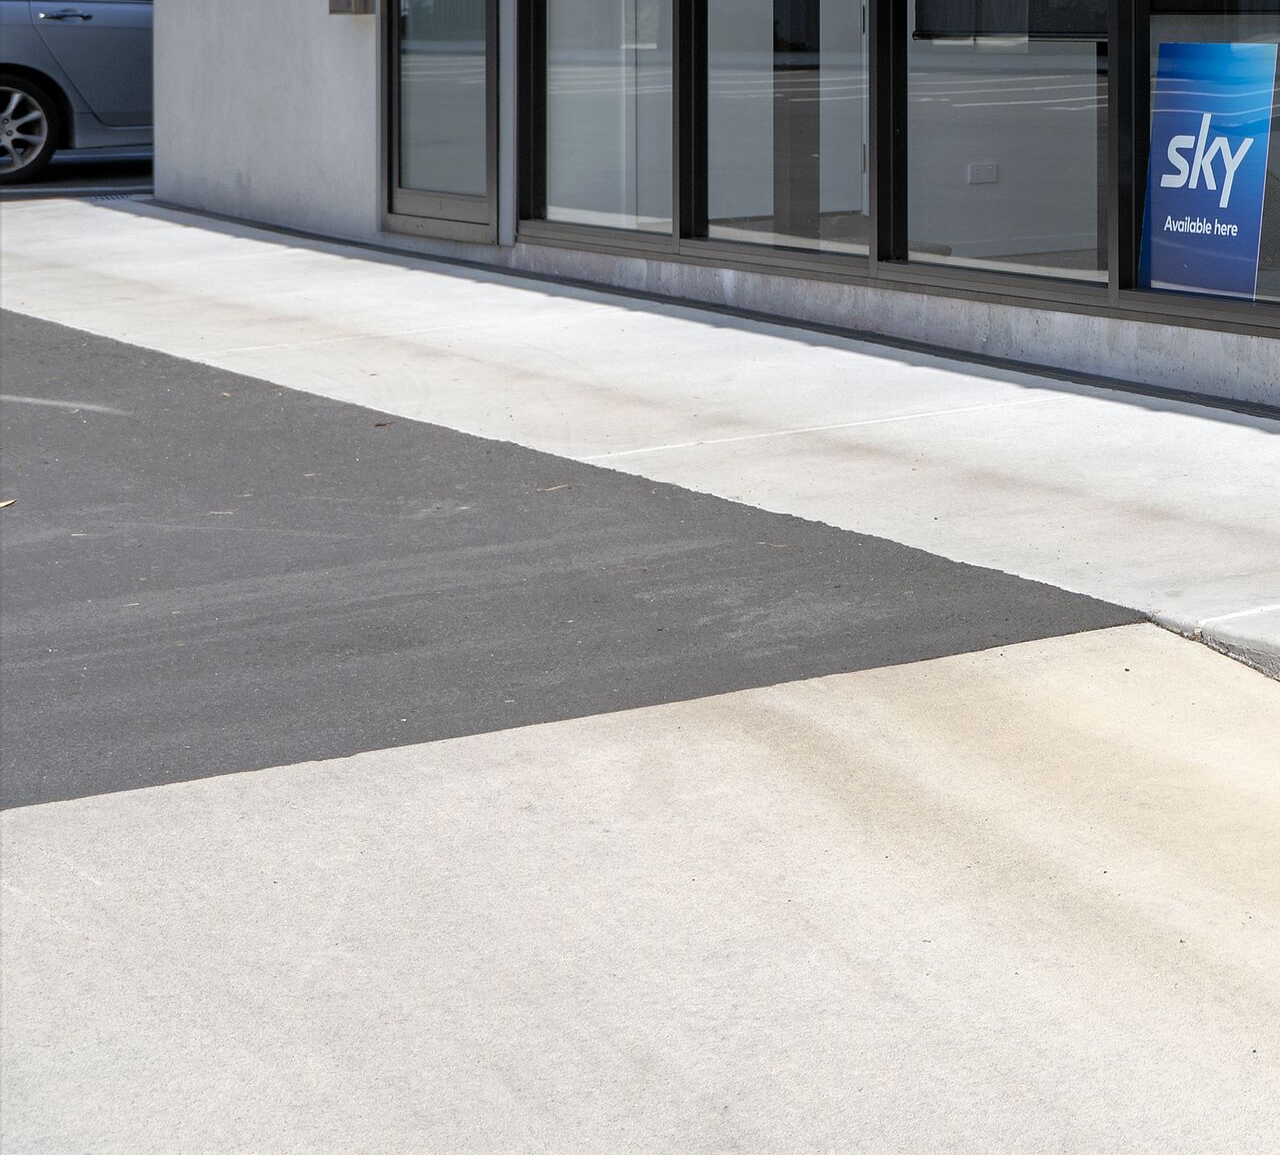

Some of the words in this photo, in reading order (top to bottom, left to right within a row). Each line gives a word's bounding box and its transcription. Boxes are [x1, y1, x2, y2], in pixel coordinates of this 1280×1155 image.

[1160, 112, 1254, 209] sky
[1163, 215, 1212, 235] Available
[1213, 218, 1238, 237] here
